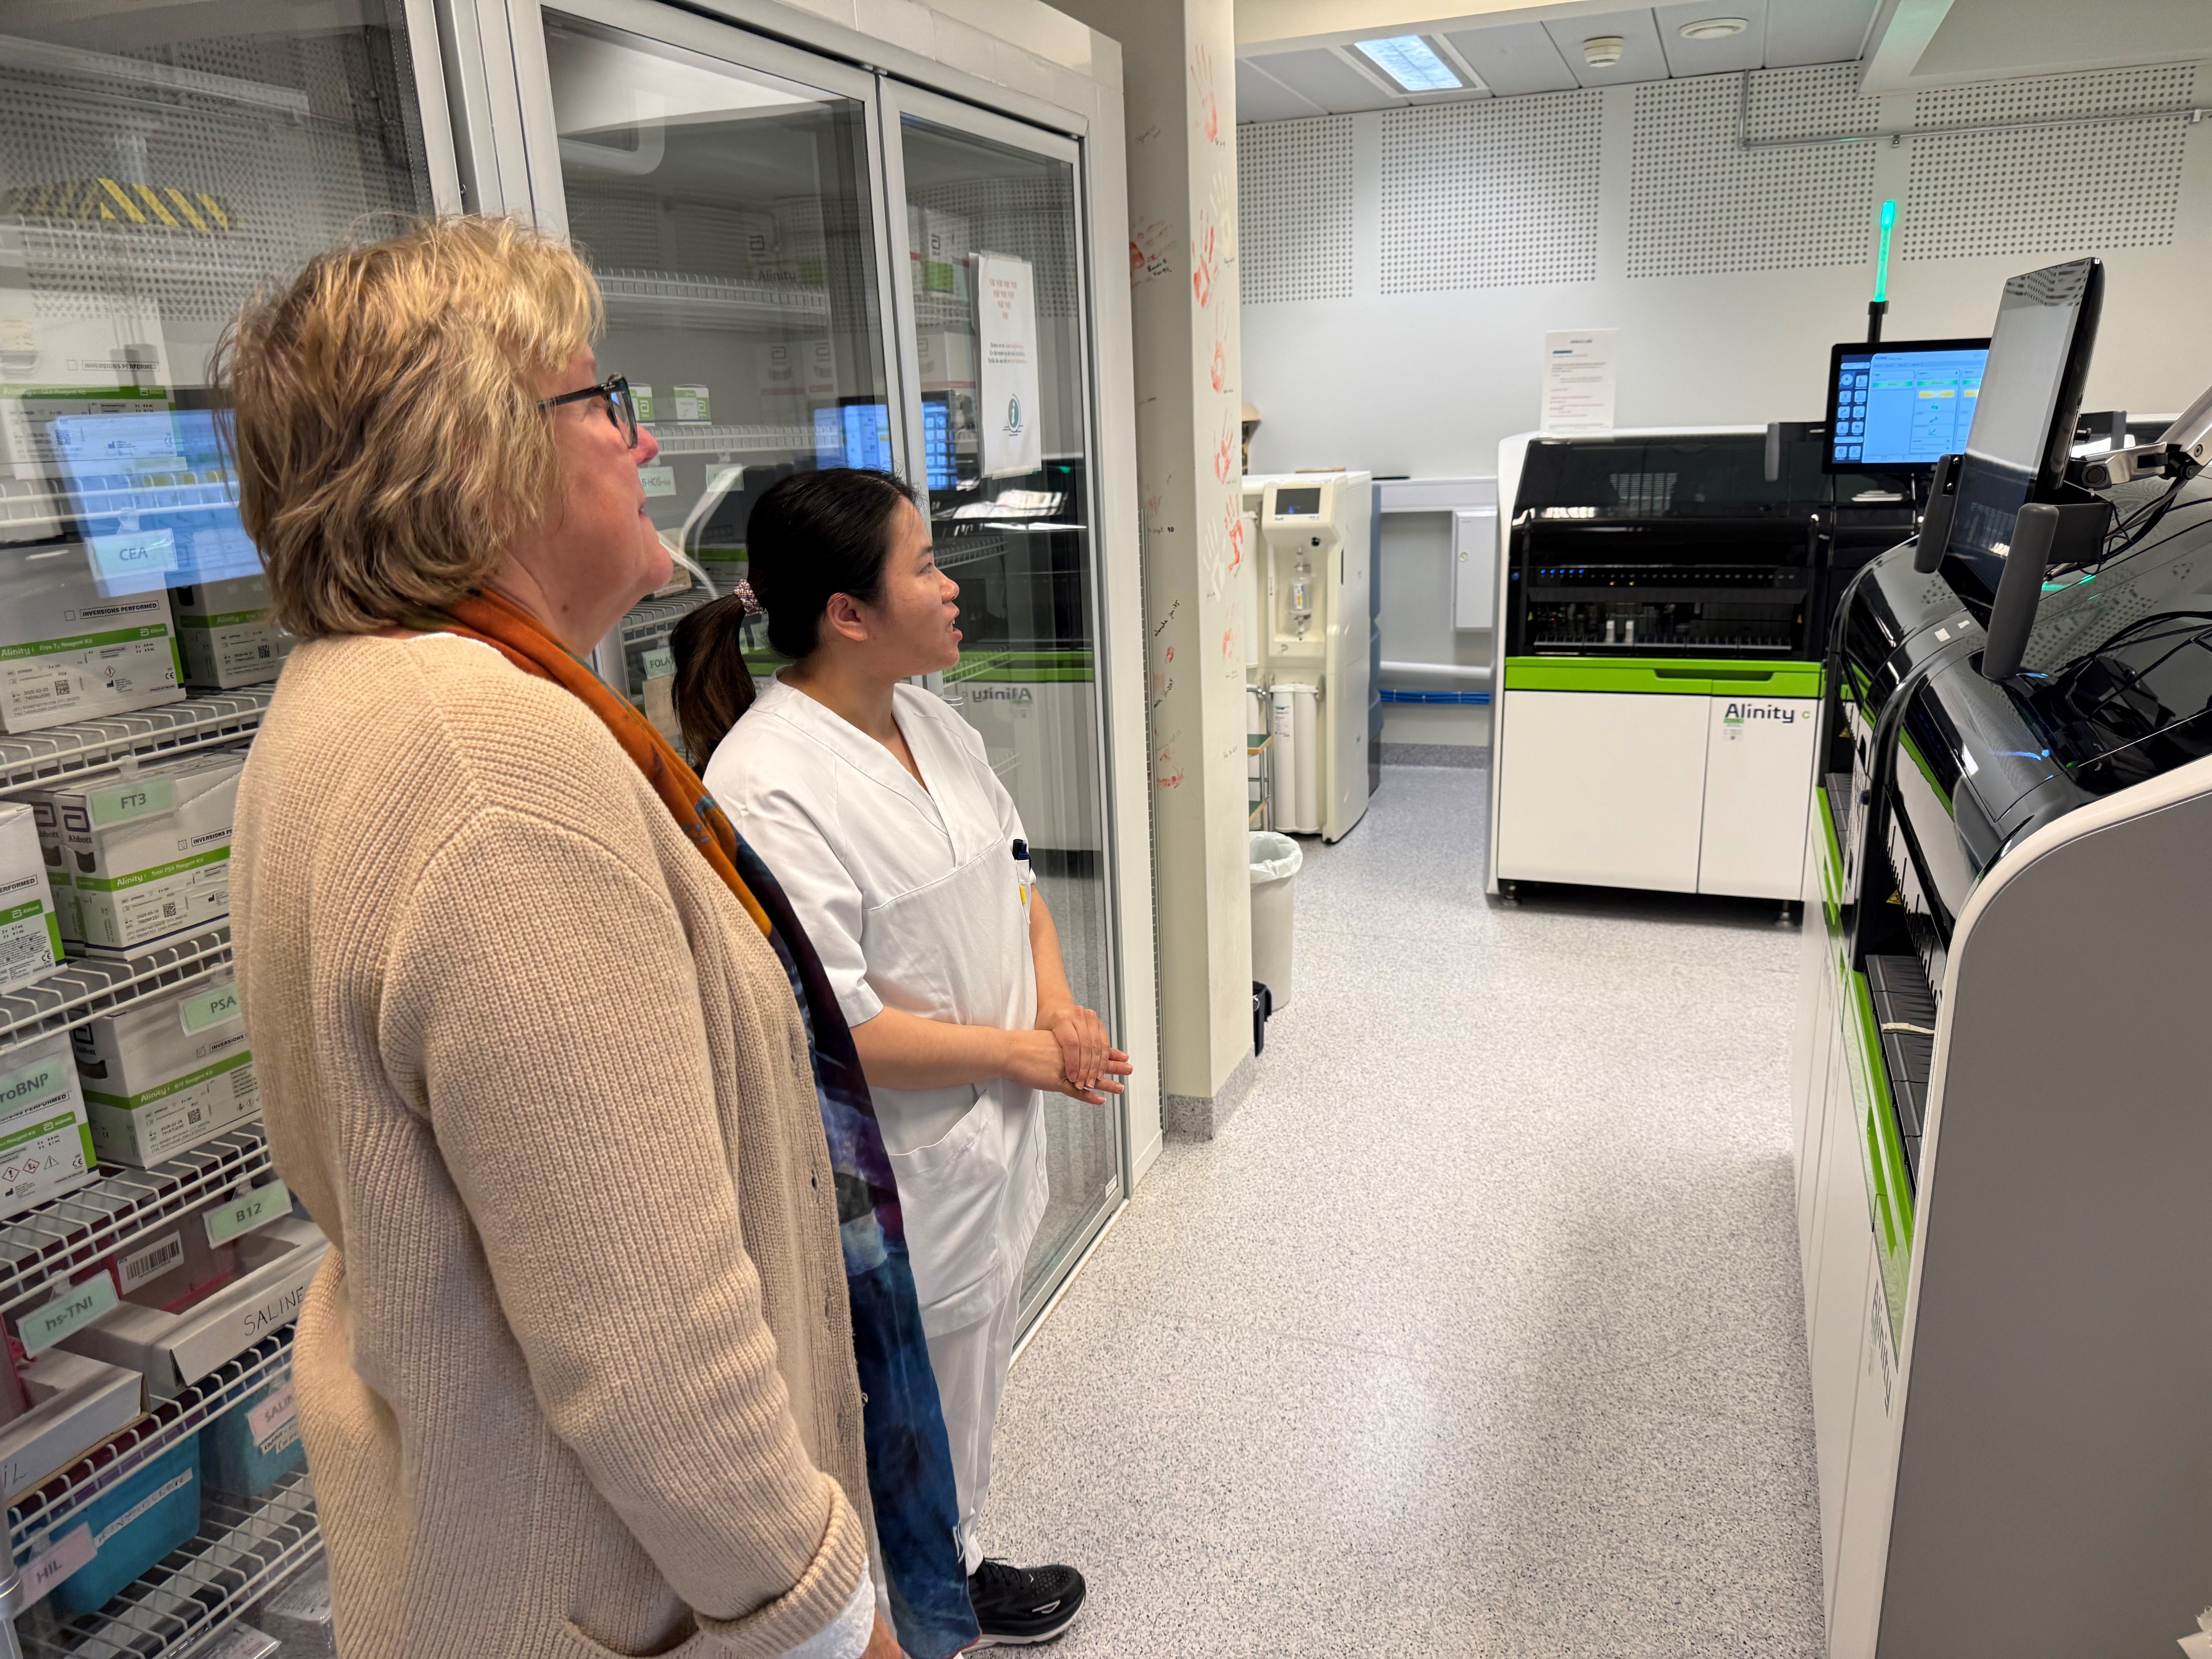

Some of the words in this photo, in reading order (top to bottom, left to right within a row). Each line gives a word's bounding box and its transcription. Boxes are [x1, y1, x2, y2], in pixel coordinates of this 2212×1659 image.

[759, 270, 796, 282] Alinity
[119, 547, 148, 561] CEA
[82, 608, 120, 618] INVERSIONS
[121, 603, 157, 613] PERFORMED
[1, 647, 30, 658] Alinity
[650, 656, 671, 669] FOLA
[1725, 704, 1795, 723] Alinity
[1802, 711, 1810, 719] c
[121, 793, 146, 809] FT3
[38, 830, 59, 838] bbott
[68, 835, 93, 844] Abbott
[193, 828, 225, 844] INVERSIONS
[117, 874, 143, 886] Alinity
[175, 860, 196, 870] Reagent
[211, 996, 236, 1013] PSA
[211, 1034, 244, 1051] INVERSIONS
[141, 1088, 167, 1102] Alinity
[236, 1203, 262, 1222] B12
[244, 1286, 304, 1336] SALINE
[36, 1560, 62, 1583] HIL
